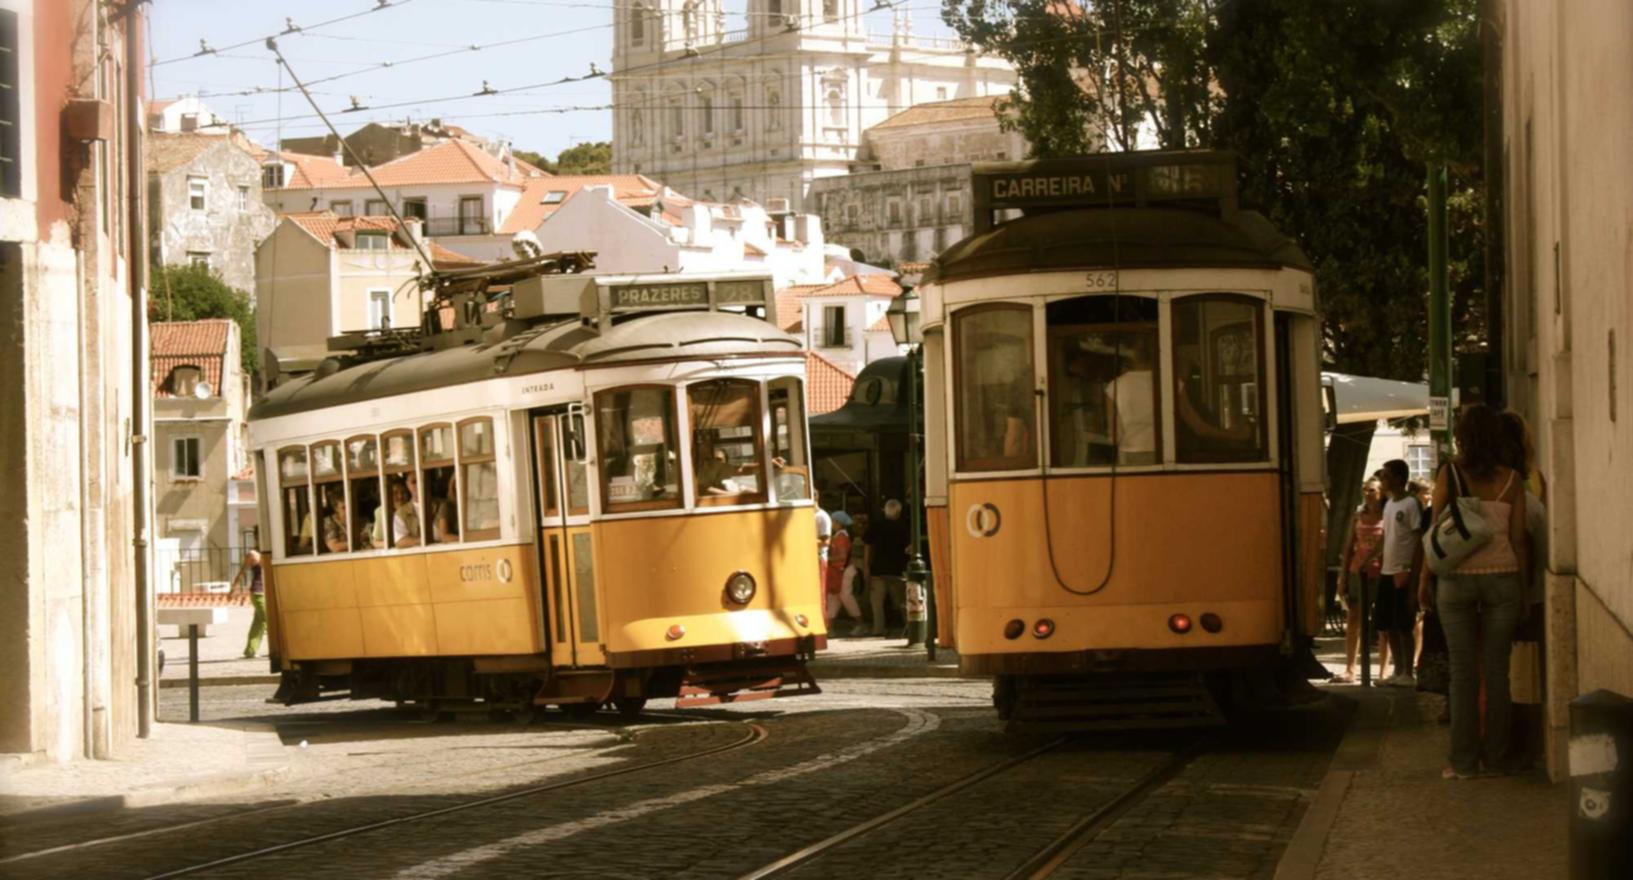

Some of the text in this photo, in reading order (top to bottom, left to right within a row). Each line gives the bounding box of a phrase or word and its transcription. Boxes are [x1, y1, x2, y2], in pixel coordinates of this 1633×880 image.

[993, 176, 1095, 198] CARREIRA
[1086, 272, 1116, 288] 562
[618, 286, 701, 304] PRAZERES
